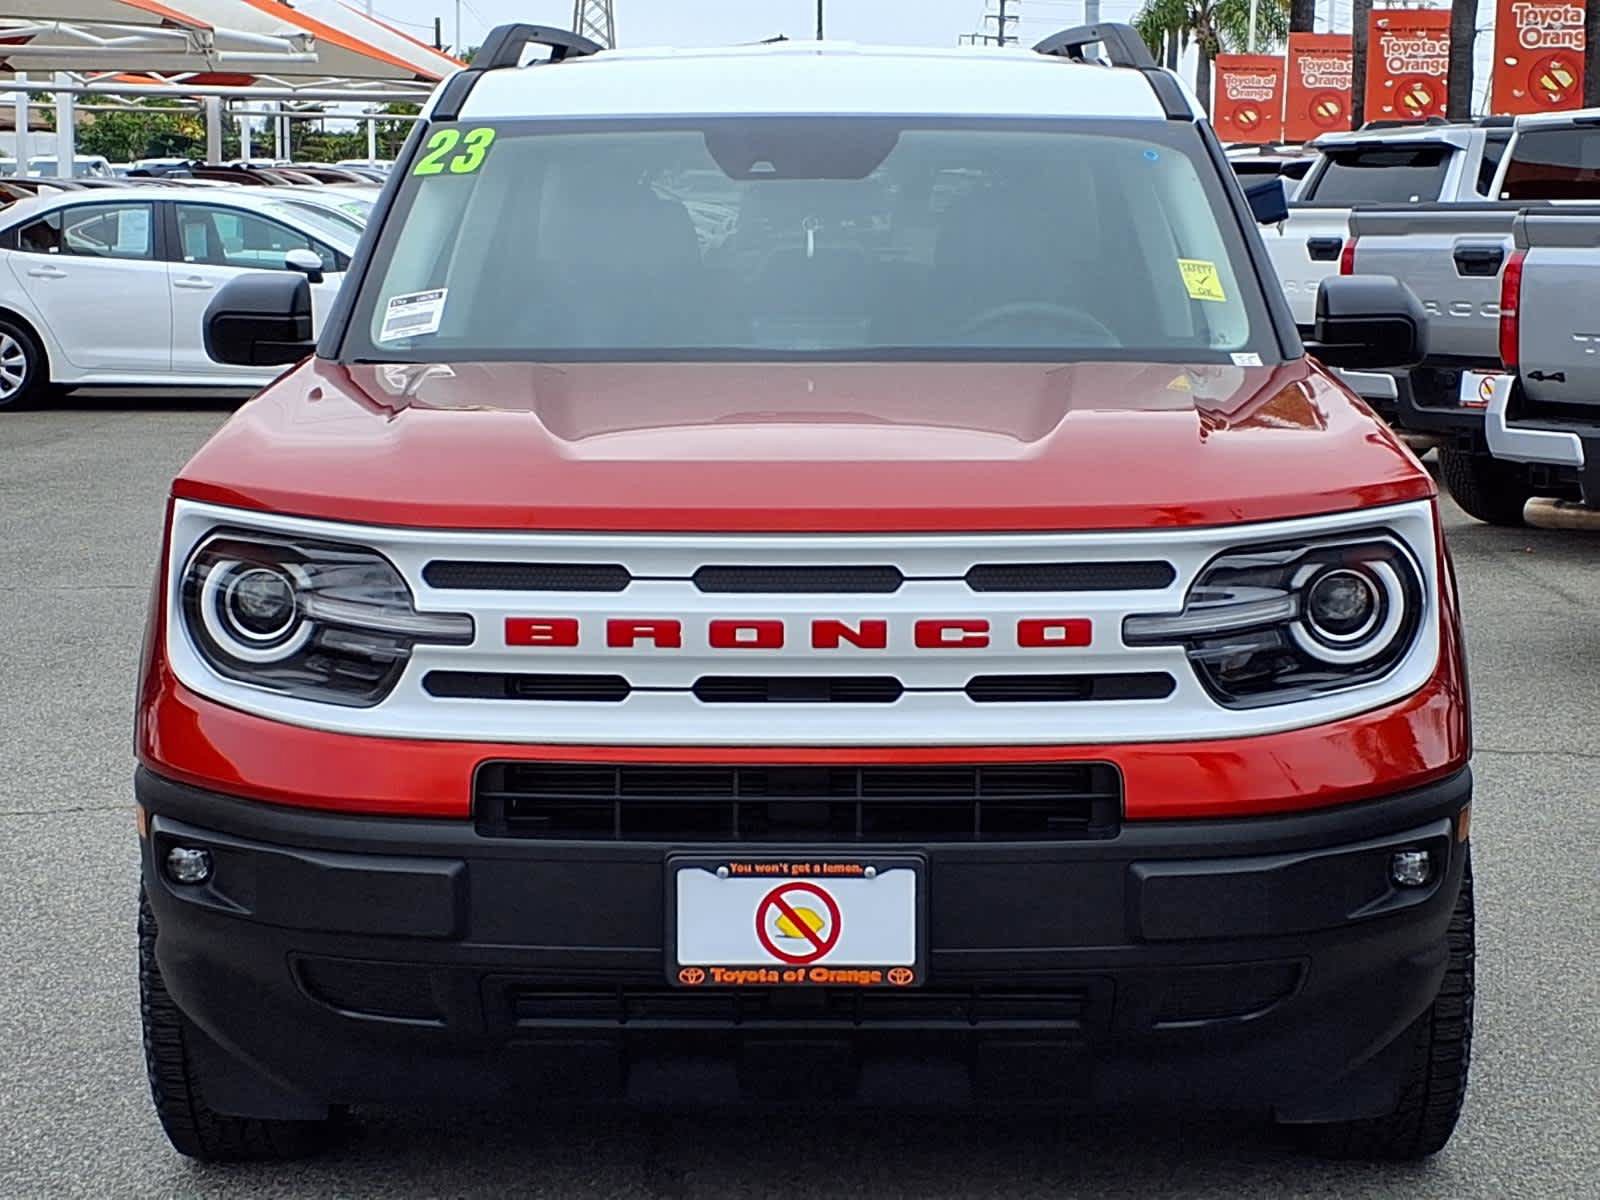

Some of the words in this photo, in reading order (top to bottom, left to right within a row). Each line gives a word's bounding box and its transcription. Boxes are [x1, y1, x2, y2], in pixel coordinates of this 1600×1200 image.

[1513, 4, 1583, 27] Toyota
[1382, 38, 1438, 55] Toyota
[1521, 27, 1585, 49] Orang
[1299, 58, 1345, 74] Toyota
[1224, 74, 1262, 88] Toyota
[1228, 86, 1272, 100] Orange
[413, 127, 496, 175] 23
[504, 617, 1092, 649] BRONCO
[730, 862, 752, 873] You
[754, 862, 789, 873] won't
[791, 862, 811, 876] get
[813, 864, 821, 873] a
[710, 967, 779, 984] Toyota
[783, 968, 806, 982] of
[808, 967, 882, 984] Orange
